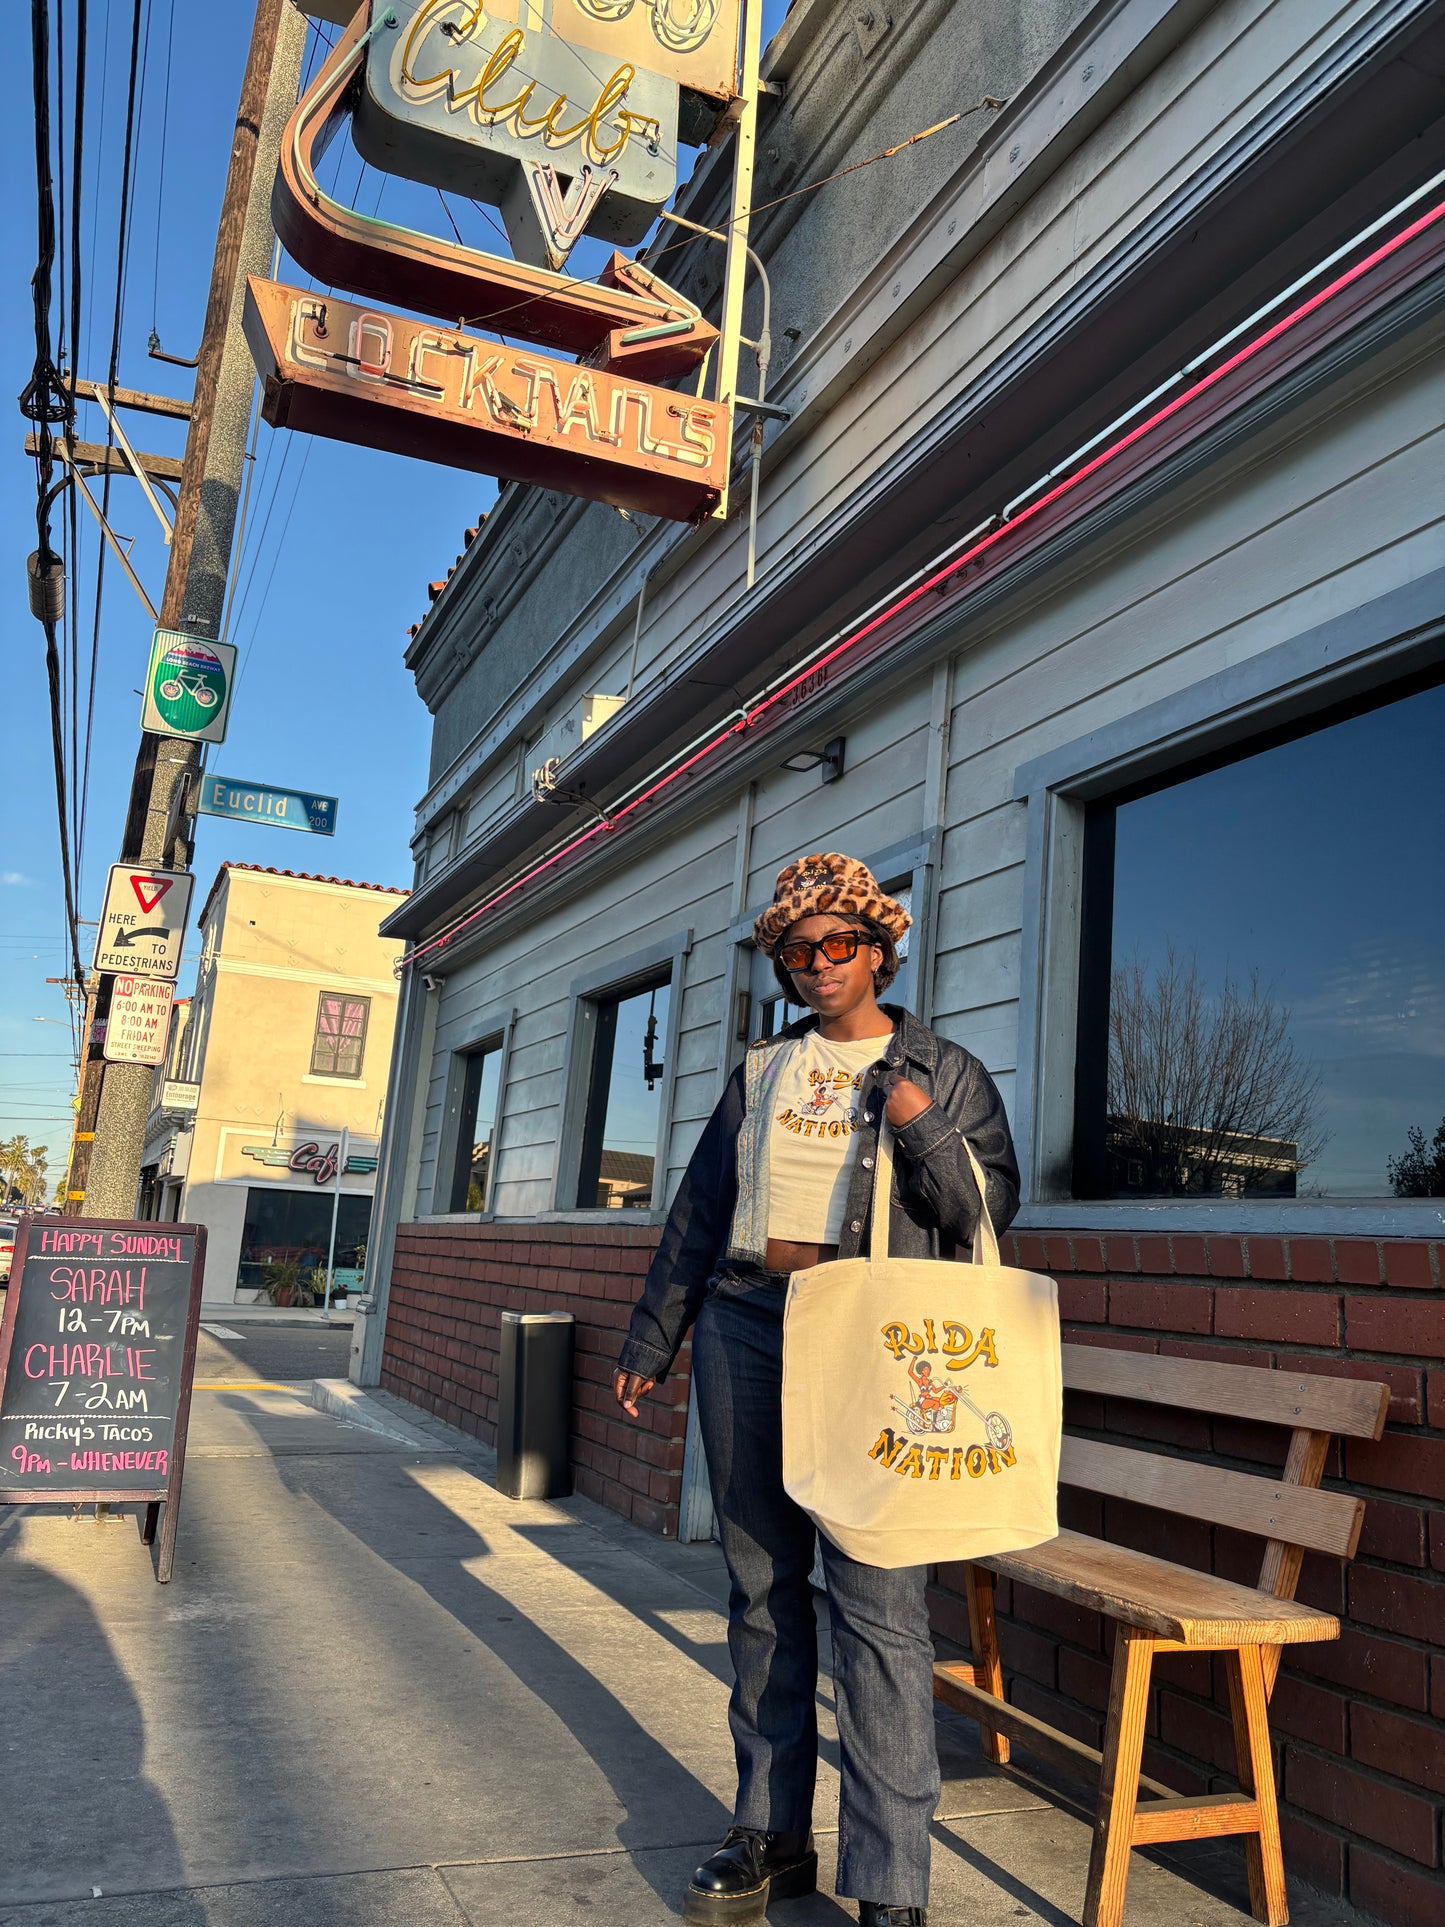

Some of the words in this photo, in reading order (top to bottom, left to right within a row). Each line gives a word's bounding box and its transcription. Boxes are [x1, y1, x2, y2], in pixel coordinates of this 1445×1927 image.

[390, 0, 660, 166] Club
[284, 298, 716, 468] COCKTAILS
[166, 657, 181, 665] LONG
[182, 661, 200, 669] BEACH
[212, 783, 288, 817] Euclid
[311, 799, 329, 812] AVE
[308, 816, 328, 828] 200
[108, 912, 137, 926] HERE
[151, 943, 167, 955] TO
[101, 953, 174, 971] PEDESTRIANS
[116, 979, 132, 994] NO
[133, 982, 171, 999] PARKING
[116, 1000, 138, 1012] 6:00
[140, 1003, 153, 1014] AM
[156, 1005, 167, 1015] TO
[121, 1015, 142, 1027] 8:00
[144, 1018, 158, 1029] AM
[111, 1041, 131, 1050] STREET
[132, 1043, 161, 1053] SWEEPING
[121, 1029, 155, 1042] FRIDAY
[808, 1067, 864, 1091] RIDA
[776, 1109, 859, 1138] NATION
[41, 1230, 103, 1255] HAPPY
[110, 1233, 181, 1262] SUNDAY
[50, 1266, 147, 1311] SARAH
[881, 1318, 999, 1372] RIDA
[24, 1343, 157, 1381] CHARLIE
[70, 1449, 169, 1476] WHENEVER
[867, 1427, 1018, 1481] NATION
